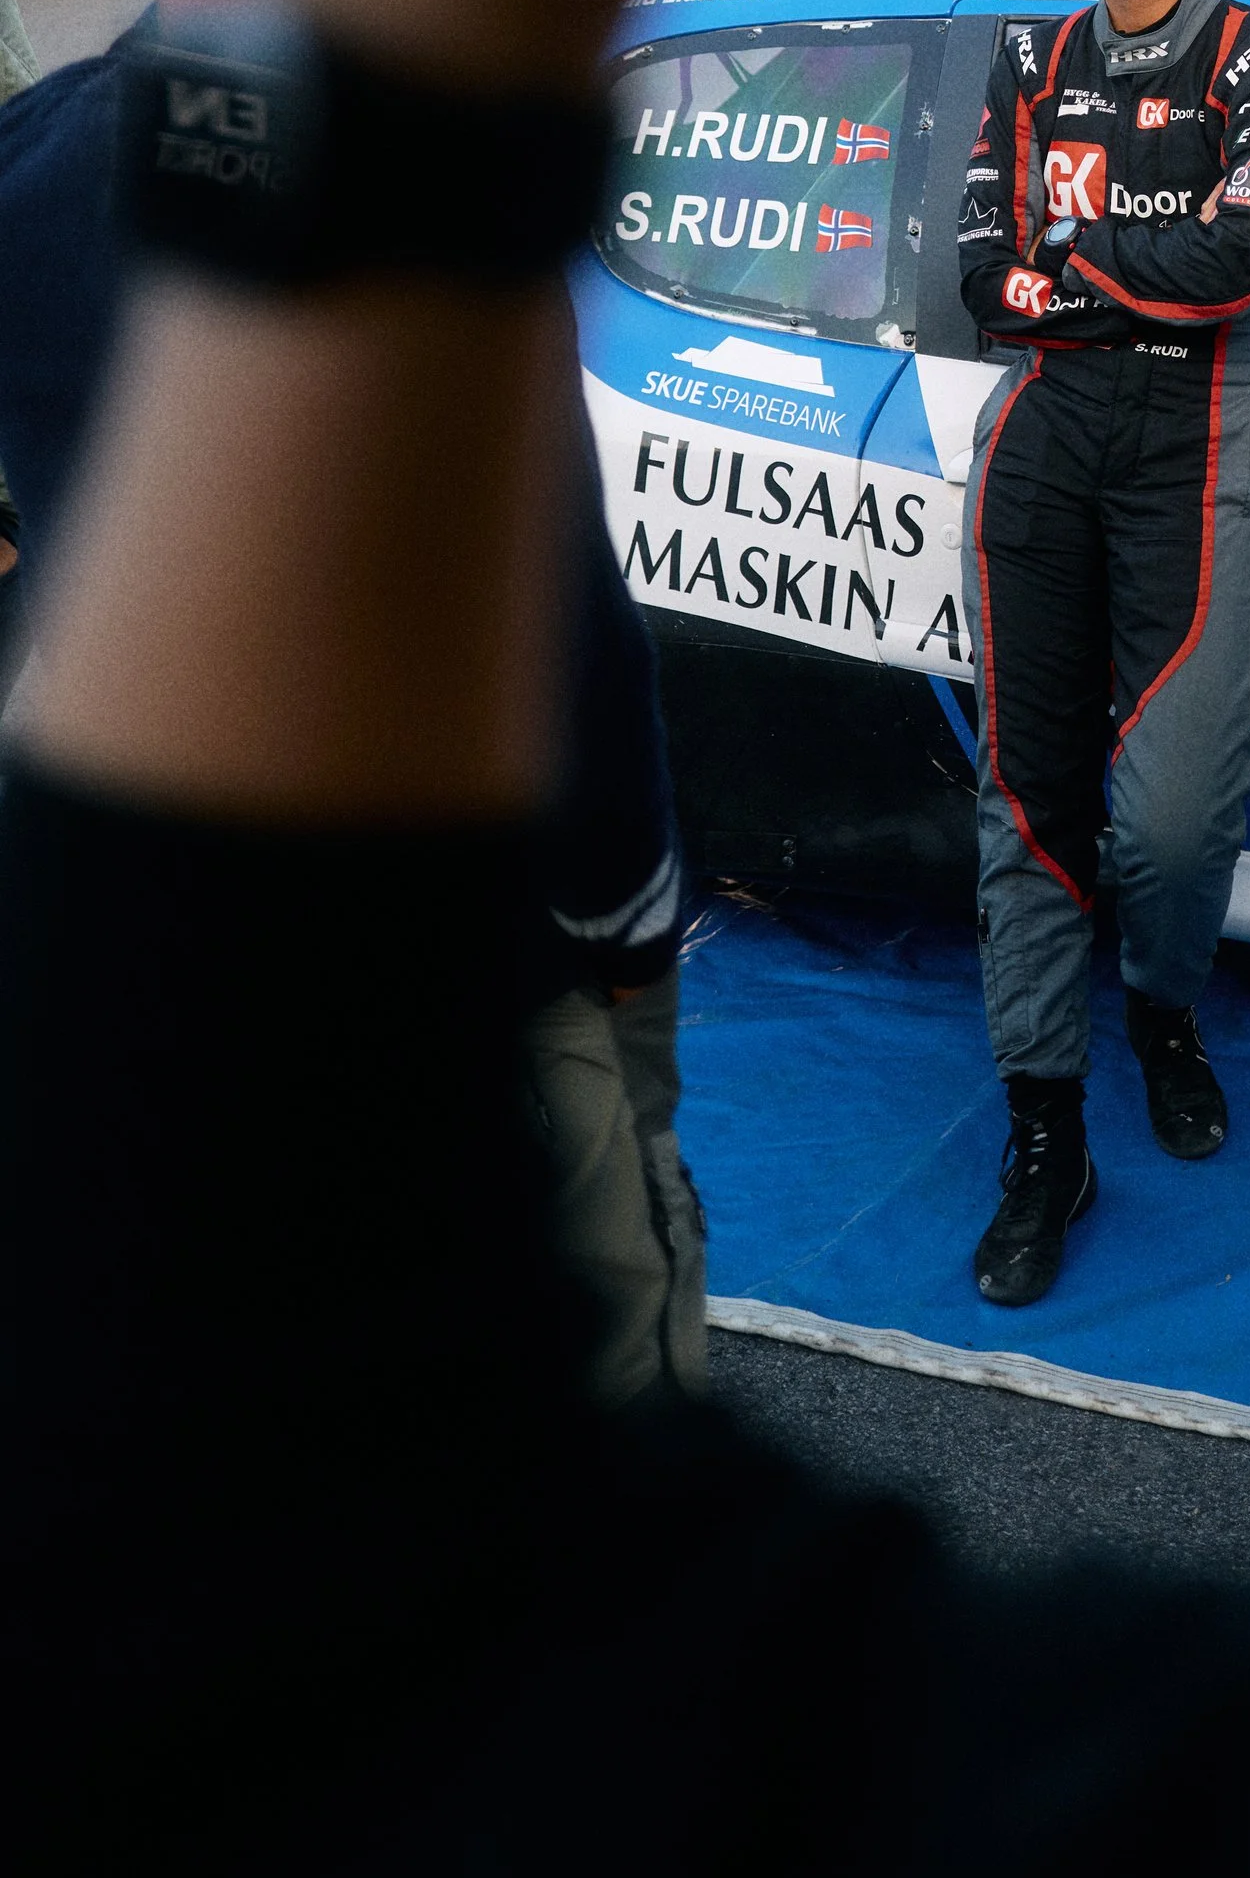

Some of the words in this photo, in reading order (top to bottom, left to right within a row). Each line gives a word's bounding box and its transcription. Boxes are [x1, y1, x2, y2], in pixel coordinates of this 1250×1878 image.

[1110, 41, 1170, 64] HRX
[1064, 88, 1090, 98] BYGG
[1074, 97, 1108, 107] KAKEL
[1140, 101, 1167, 126] GK
[1171, 108, 1194, 121] Door
[632, 108, 828, 164] H.RUDI
[1043, 150, 1100, 220] GK
[1110, 182, 1192, 219] Door
[615, 191, 808, 253] S.RUDI
[1006, 272, 1049, 314] GK
[641, 370, 708, 406] SKUE
[707, 385, 846, 438] SPAREBANK
[633, 430, 926, 558] FULSAAS
[623, 520, 896, 641] MASKIN
[916, 594, 974, 666] A
